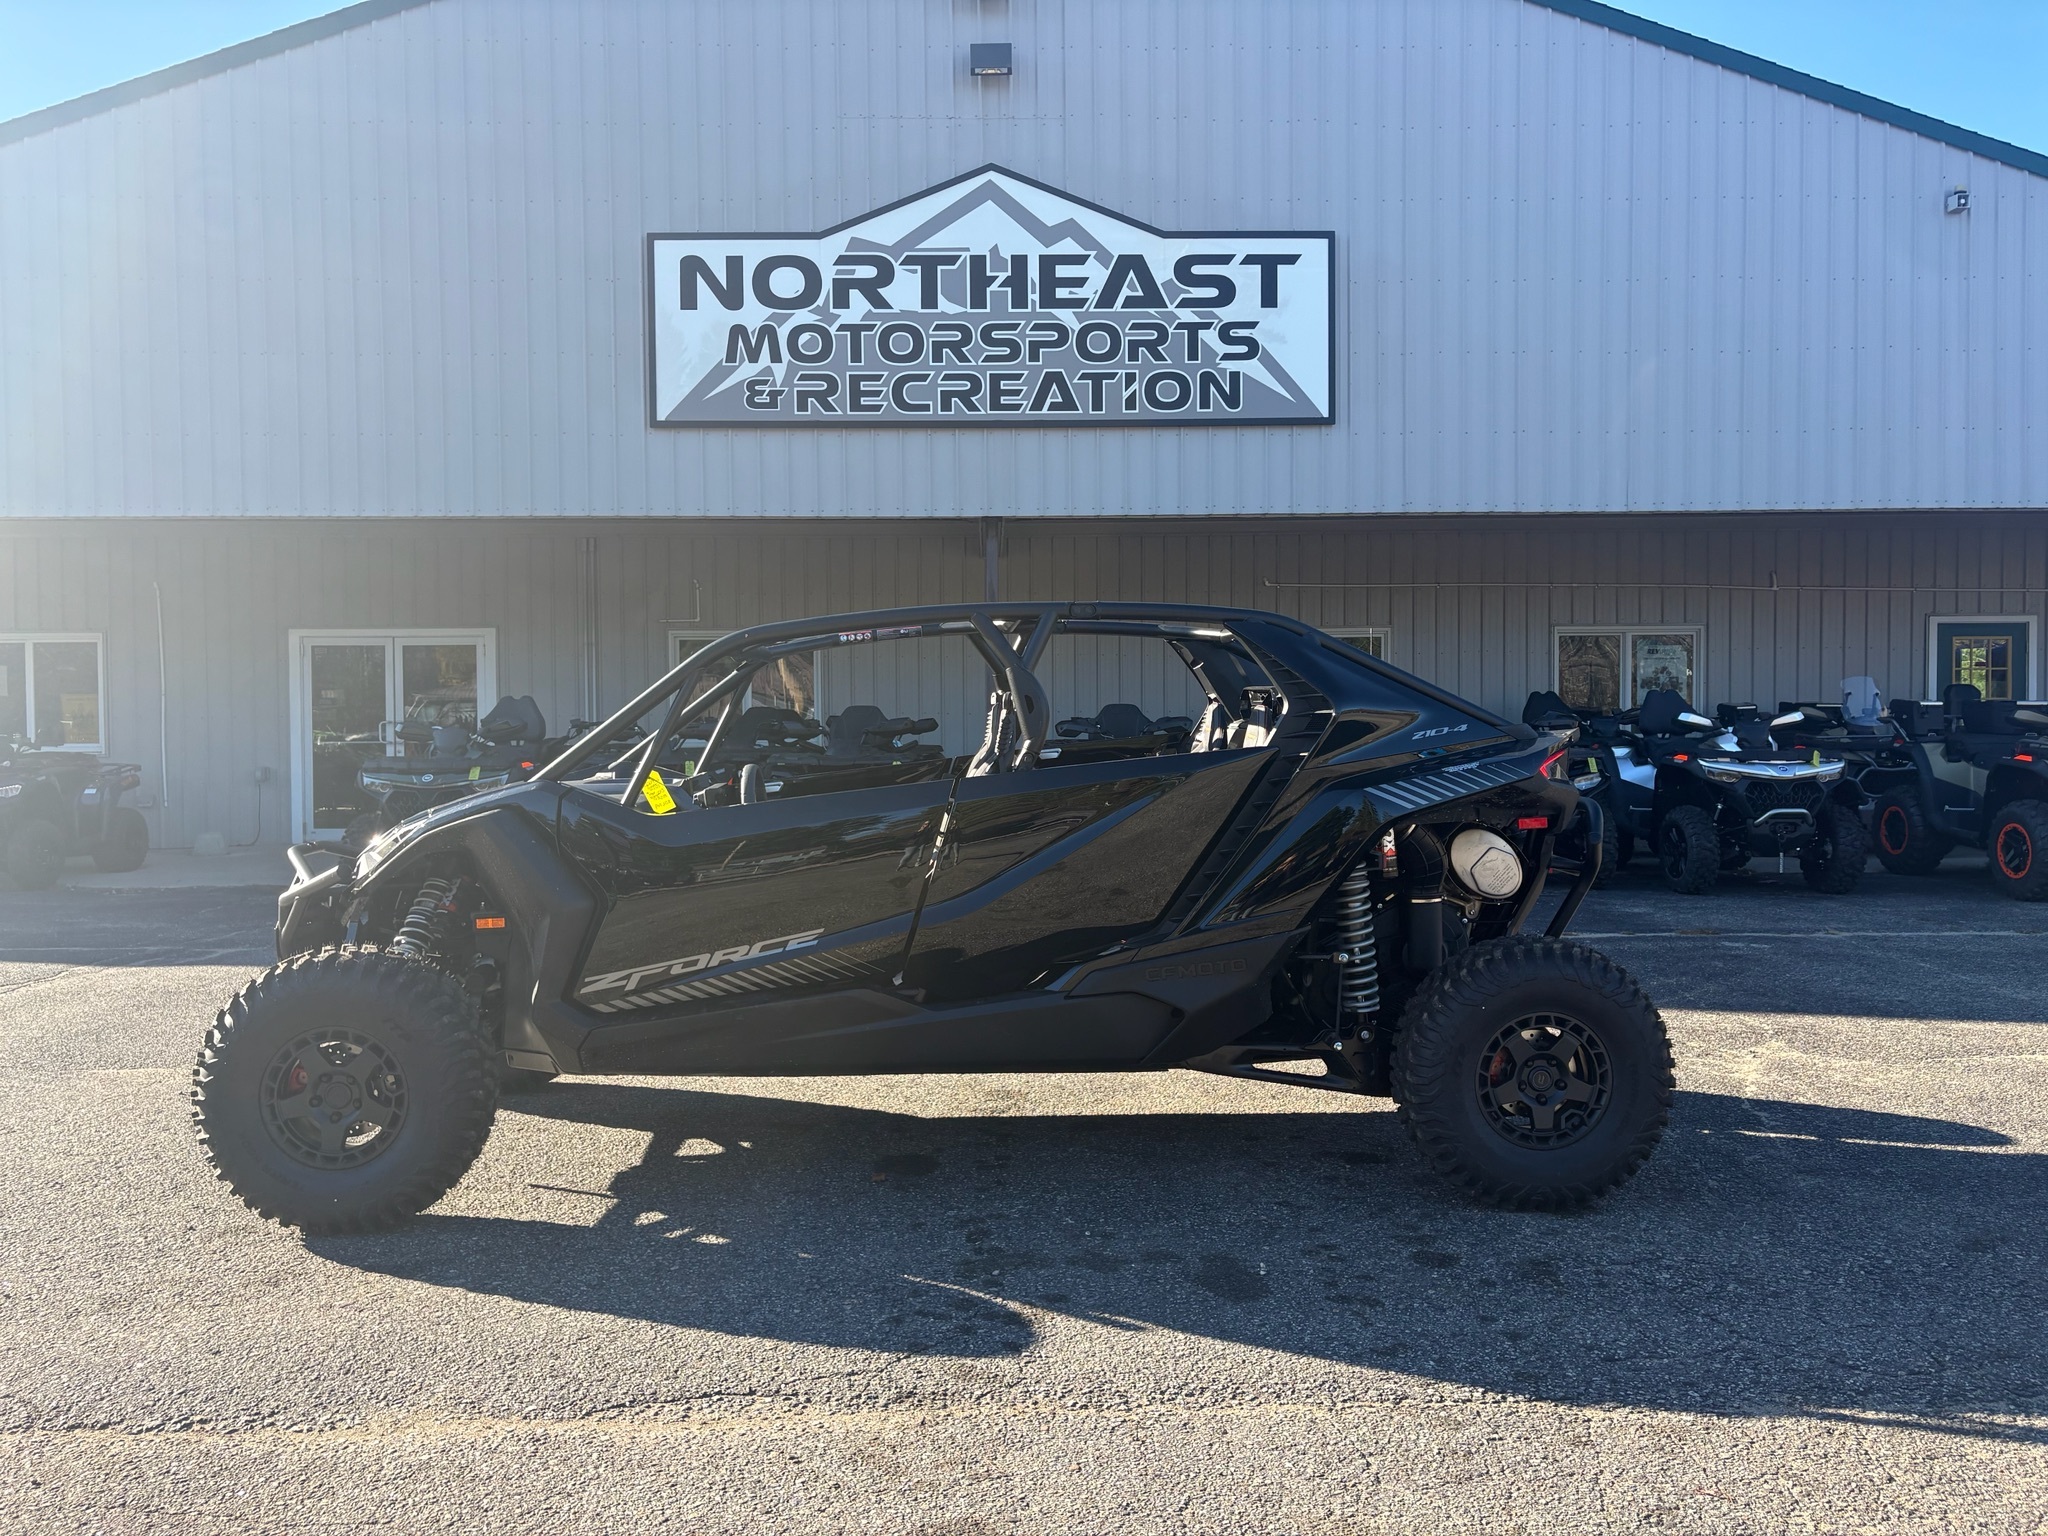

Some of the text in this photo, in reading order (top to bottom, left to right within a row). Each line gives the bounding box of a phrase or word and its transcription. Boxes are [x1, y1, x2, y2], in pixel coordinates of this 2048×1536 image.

[679, 253, 1302, 311] NORTHEAST
[723, 321, 1260, 364] MOTORSPORTS
[580, 928, 825, 994] ZFORCE
[1146, 960, 1246, 981] CFMOTO
